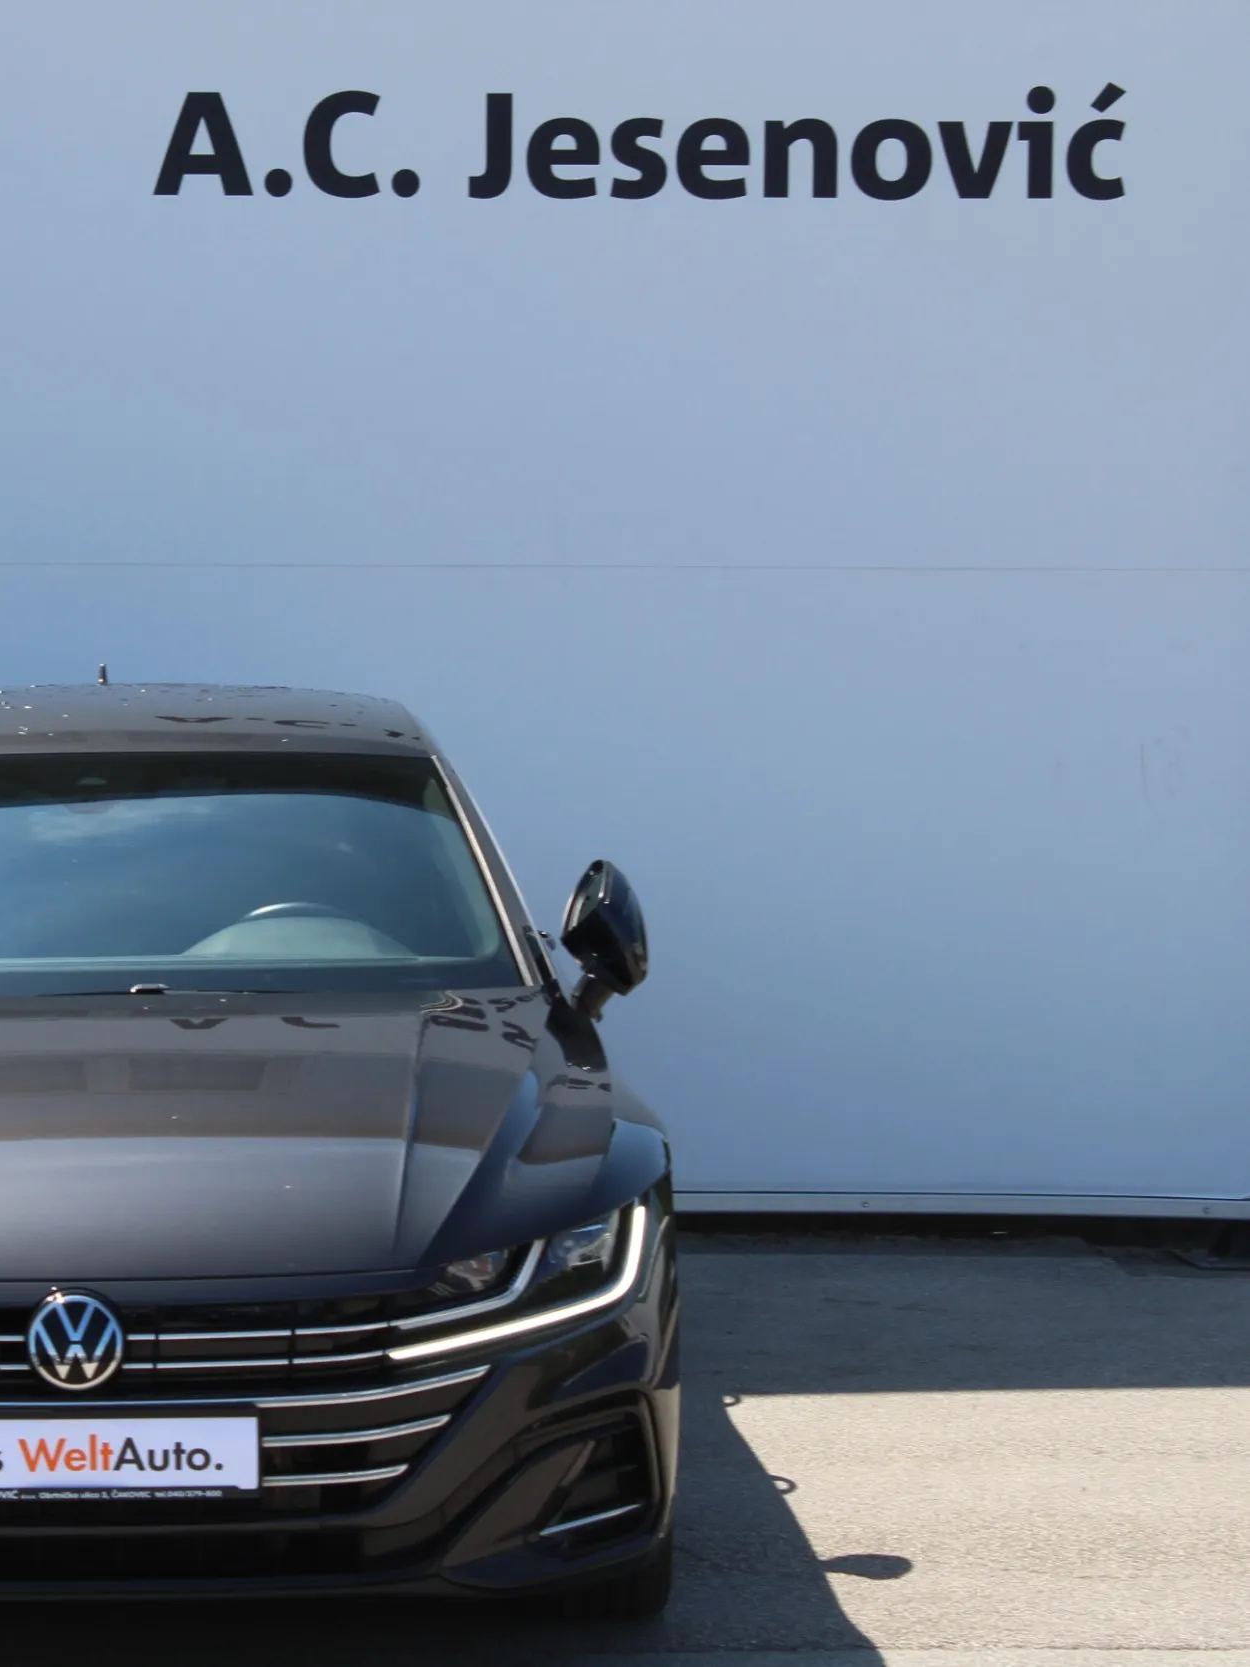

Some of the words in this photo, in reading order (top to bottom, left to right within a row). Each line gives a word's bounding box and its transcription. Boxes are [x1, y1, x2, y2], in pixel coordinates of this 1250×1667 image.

[153, 90, 420, 199] A.C.
[468, 82, 1127, 201] Jesenović
[18, 1433, 224, 1473] WeltAuto.
